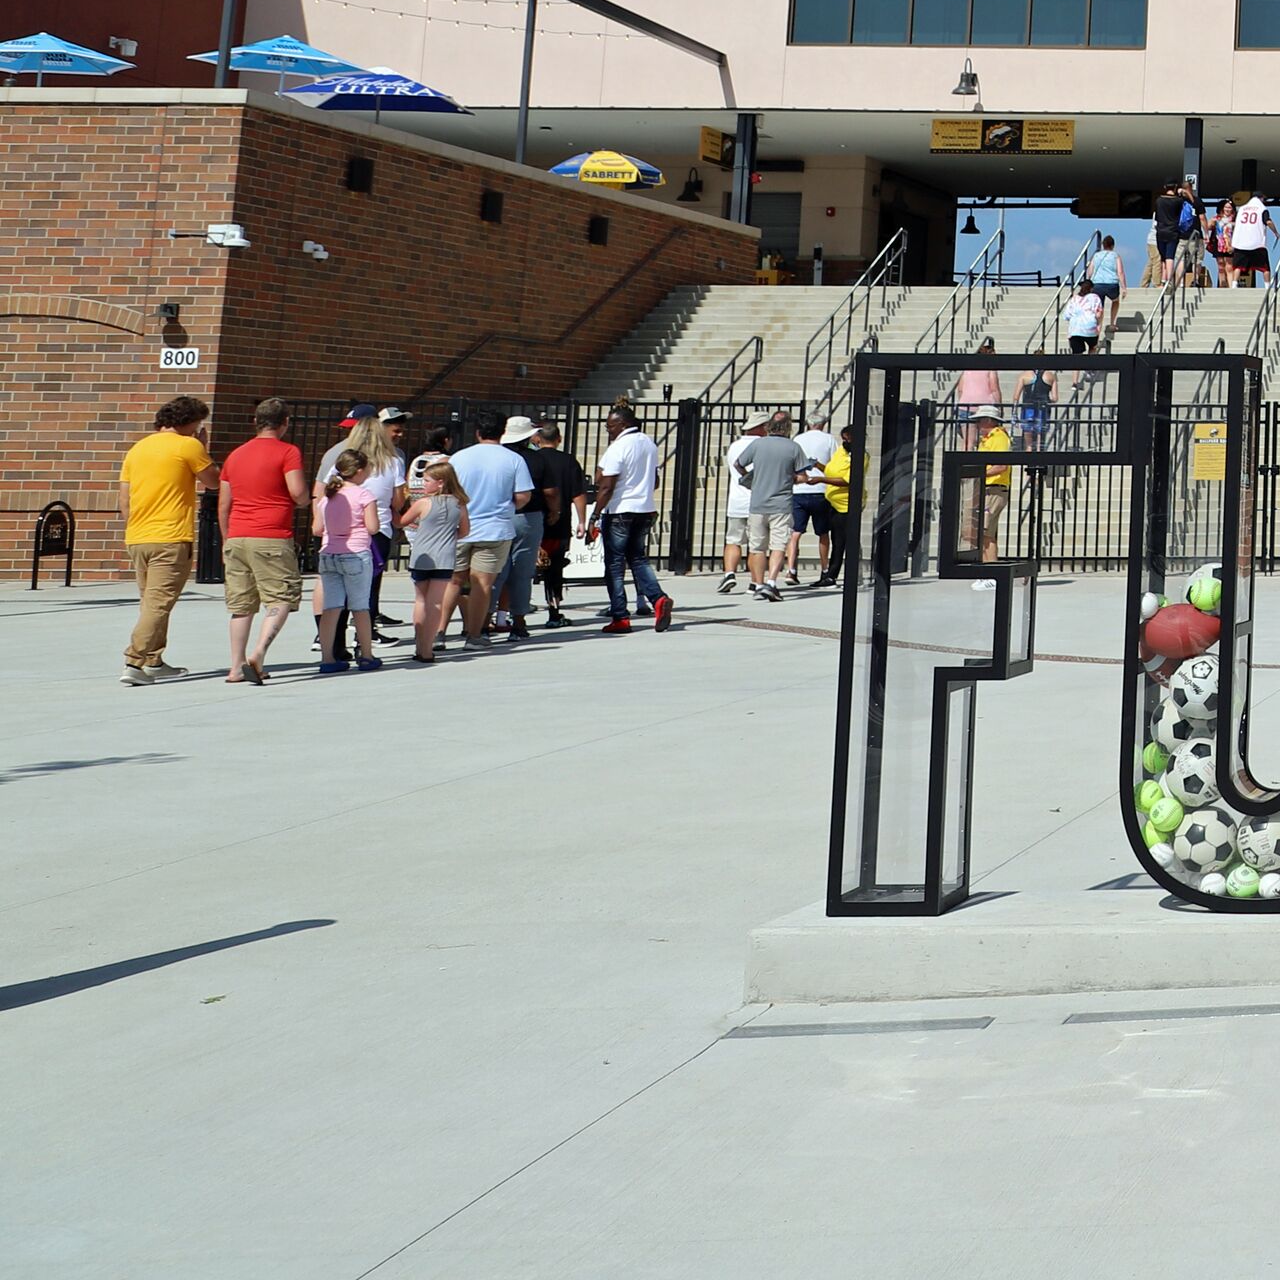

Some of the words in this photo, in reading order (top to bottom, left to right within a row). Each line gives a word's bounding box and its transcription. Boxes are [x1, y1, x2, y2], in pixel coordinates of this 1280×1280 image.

[334, 85, 436, 96] ULTRA
[584, 171, 633, 179] SABRETT
[1241, 212, 1257, 224] 30
[164, 351, 195, 365] 800
